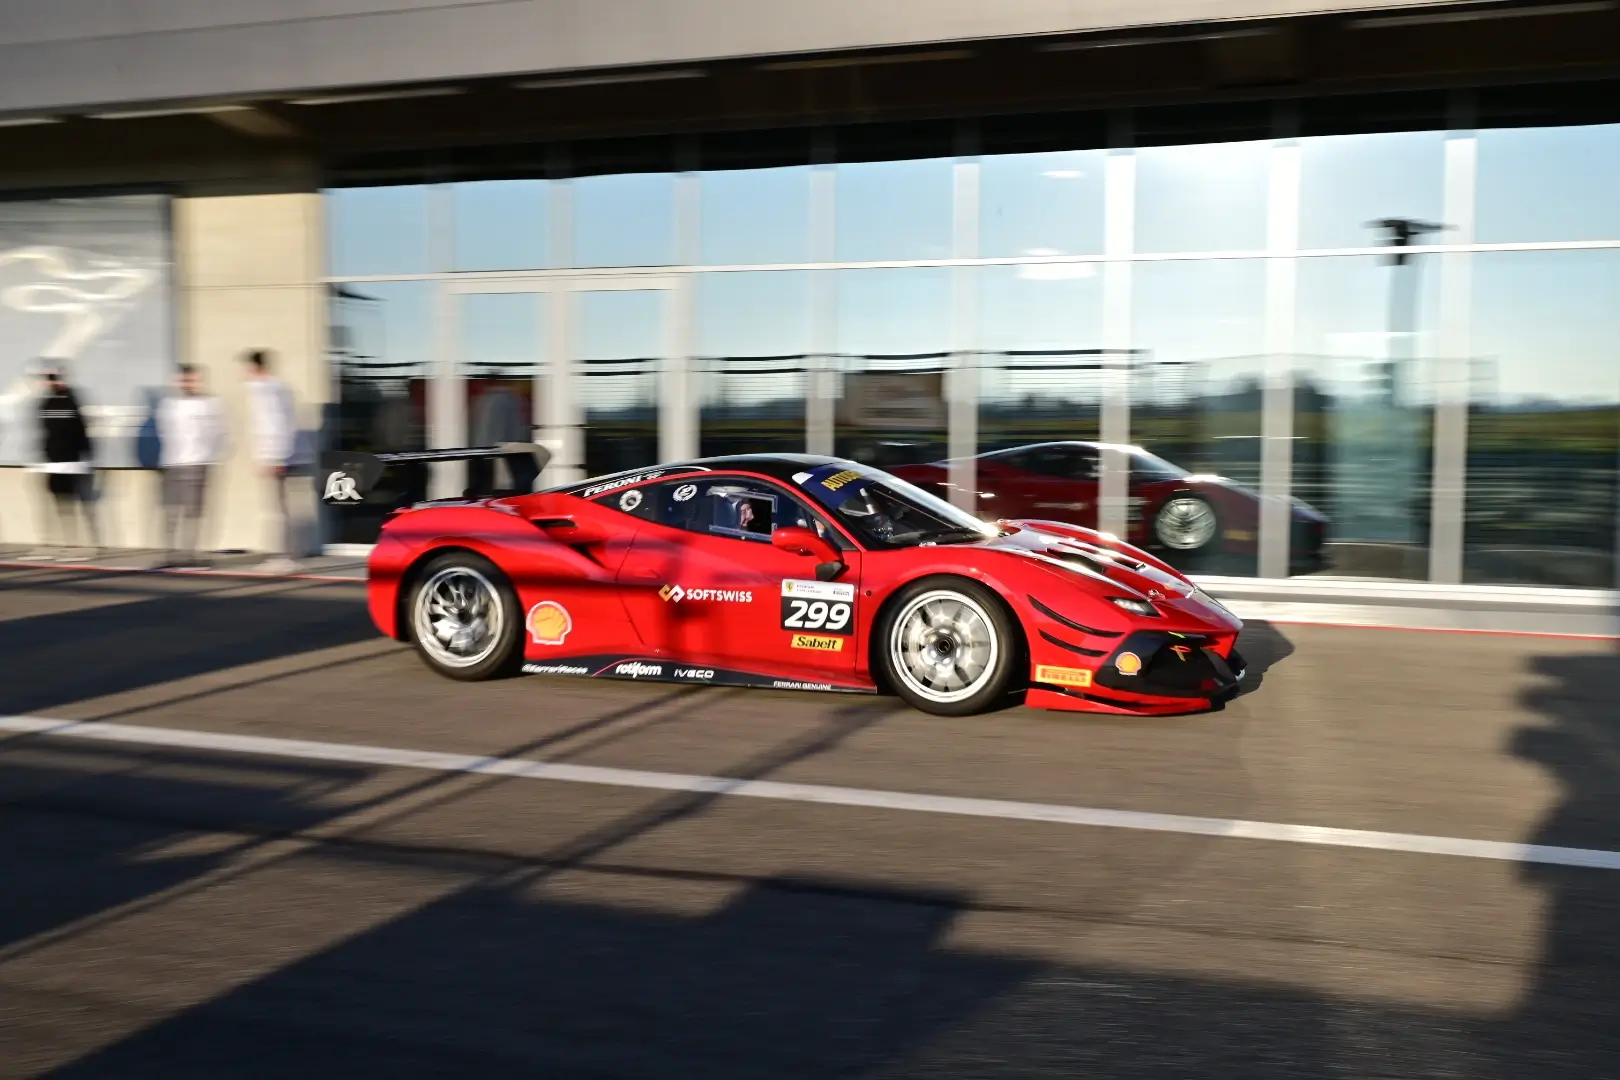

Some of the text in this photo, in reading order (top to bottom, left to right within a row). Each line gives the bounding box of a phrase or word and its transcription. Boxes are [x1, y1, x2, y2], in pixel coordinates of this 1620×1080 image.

[583, 475, 642, 497] PERONI
[686, 588, 753, 603] SOFTSWISS
[784, 600, 851, 630] 299
[796, 636, 838, 650] Sabelt
[615, 661, 663, 678] rotiform
[673, 668, 715, 679] IVECO
